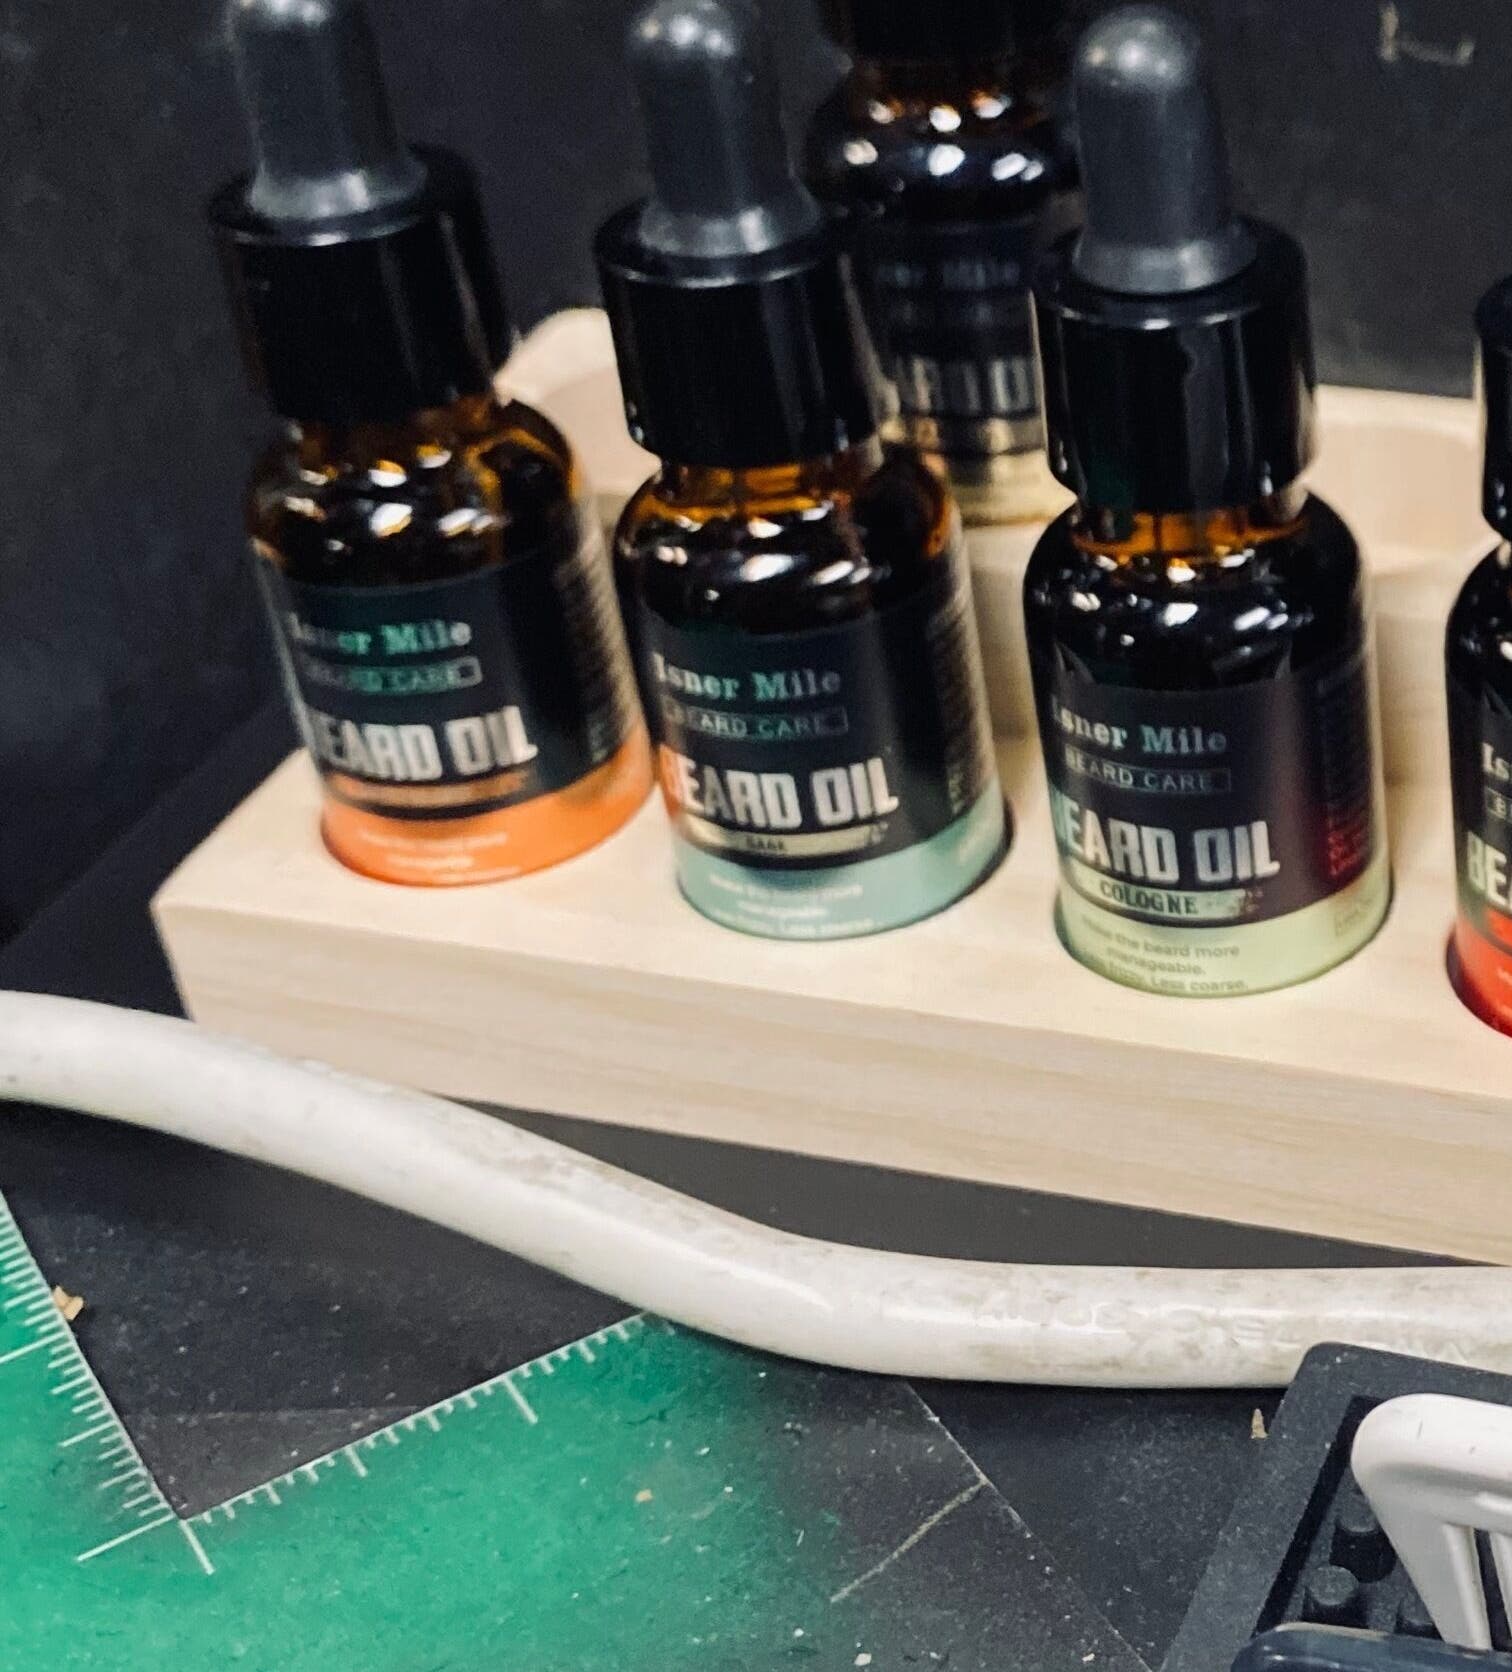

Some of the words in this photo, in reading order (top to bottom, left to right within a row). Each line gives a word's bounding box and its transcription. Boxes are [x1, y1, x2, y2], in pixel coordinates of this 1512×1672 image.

[653, 652, 739, 700] Isner
[753, 667, 841, 701] Mile
[306, 708, 443, 782] EARD
[445, 705, 538, 776] OIL
[1141, 725, 1227, 754] Mile
[810, 757, 899, 826] OIL
[1143, 769, 1214, 793] CARE
[1193, 820, 1281, 884] OIL
[1100, 879, 1199, 915] COLOGNE
[1195, 945, 1240, 958] more
